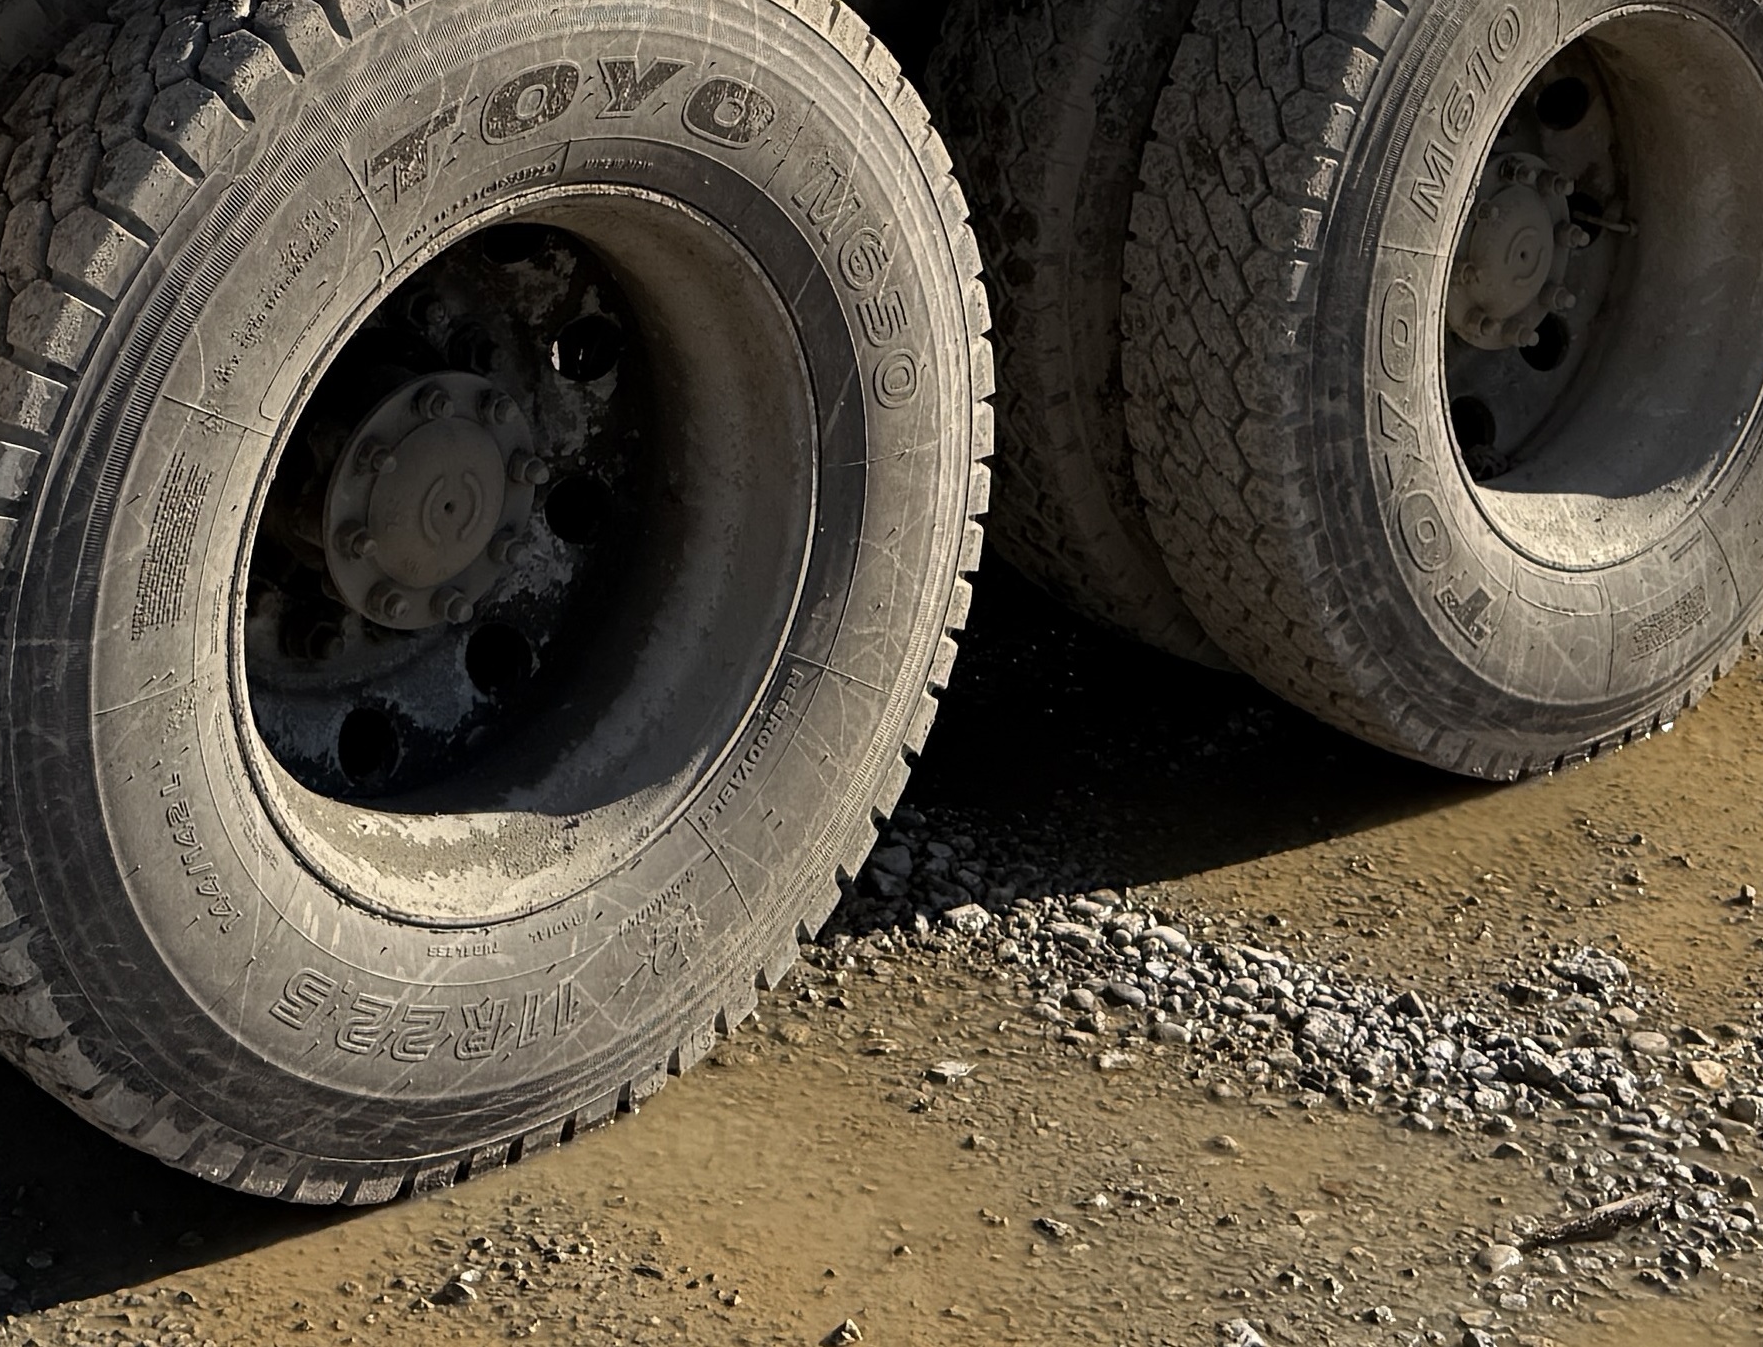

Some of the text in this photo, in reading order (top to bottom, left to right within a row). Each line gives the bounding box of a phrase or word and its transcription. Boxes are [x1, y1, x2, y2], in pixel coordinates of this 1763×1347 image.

[364, 56, 776, 203] TOYO
[1410, 4, 1520, 223] M610
[790, 159, 920, 409] M650
[1379, 277, 1497, 648] TOYO
[160, 770, 243, 934] 144/142 L
[269, 967, 580, 1062] 11R22.5
